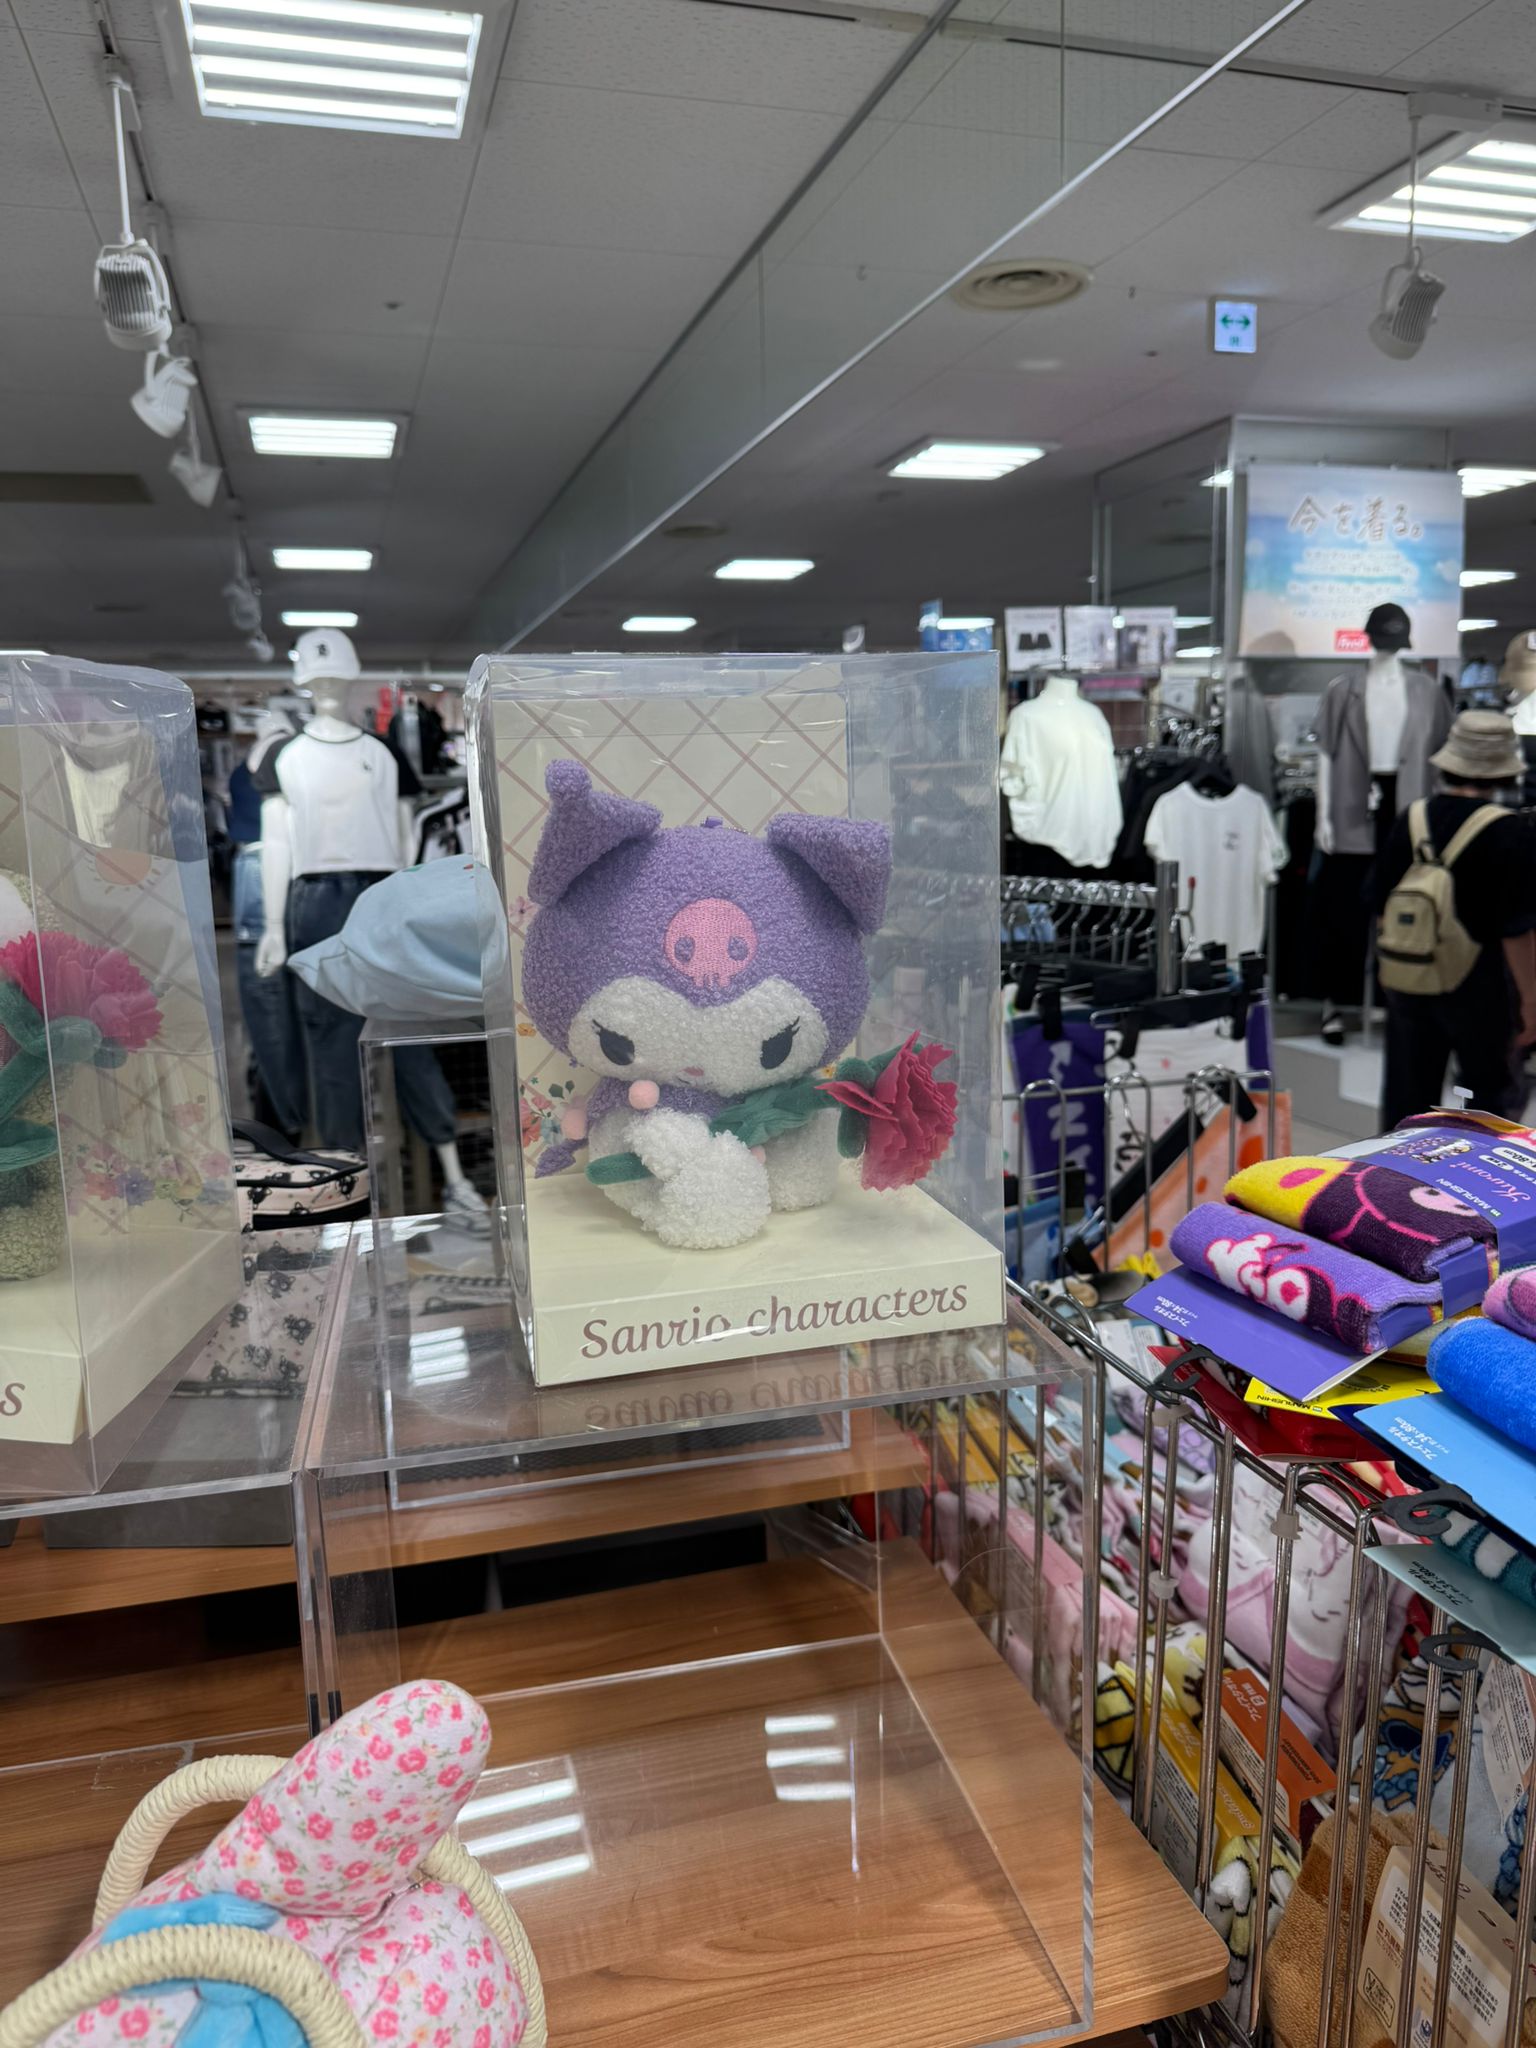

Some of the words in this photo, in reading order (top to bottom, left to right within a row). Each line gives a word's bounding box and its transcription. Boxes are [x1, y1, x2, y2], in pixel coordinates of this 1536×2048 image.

[1290, 496, 1422, 542] 今を着る。
[1435, 1178, 1492, 1210] MARUSHIN
[1449, 1161, 1531, 1203] Kuromi
[580, 1305, 732, 1360] Sanrio
[747, 1284, 969, 1337] characters
[1388, 1426, 1438, 1460] フェイスタオル
[1408, 1568, 1463, 1606] フェイスタオル
[1222, 1675, 1263, 1722] フェイスタオル
